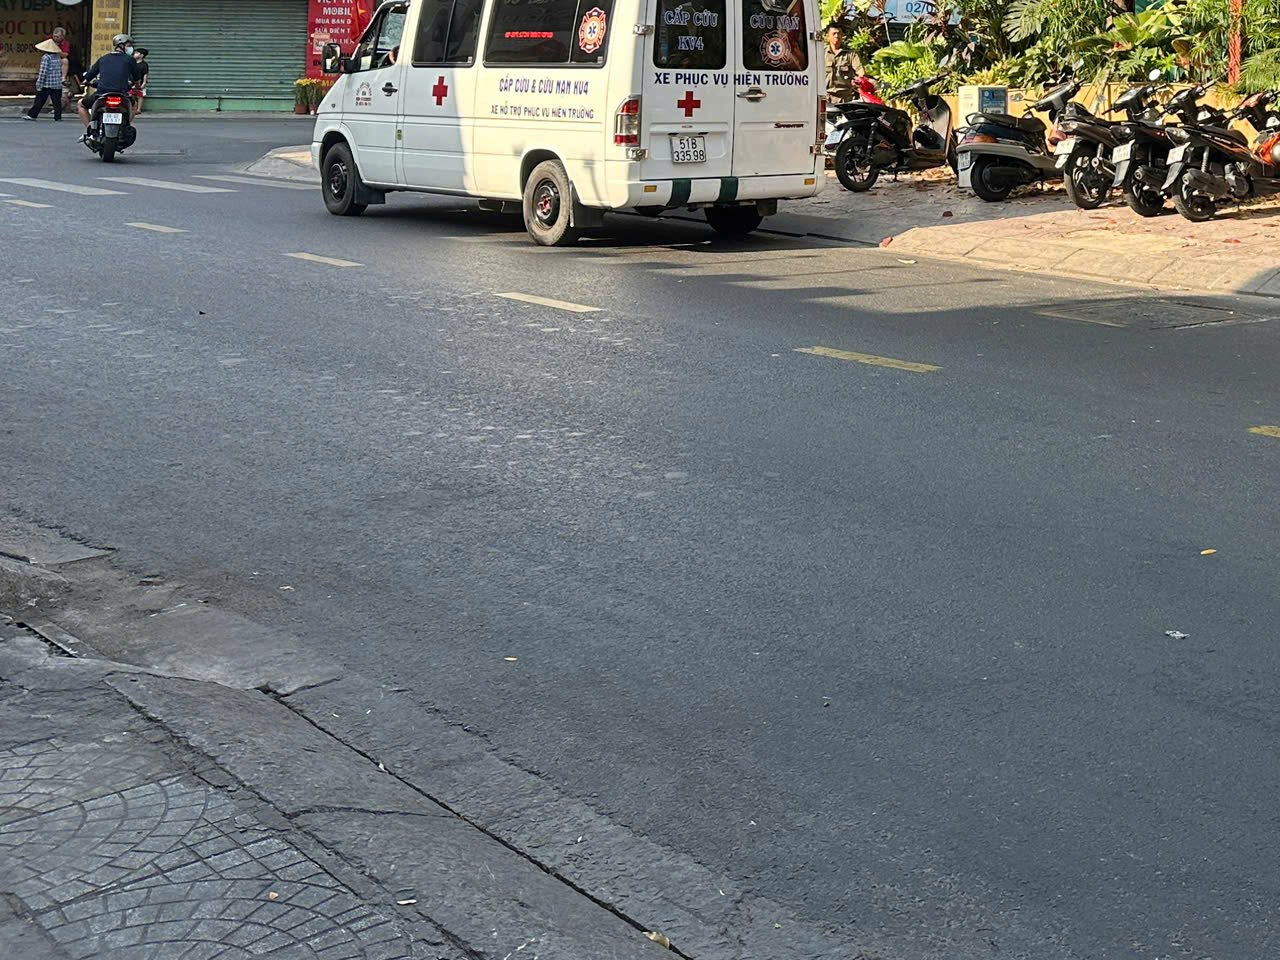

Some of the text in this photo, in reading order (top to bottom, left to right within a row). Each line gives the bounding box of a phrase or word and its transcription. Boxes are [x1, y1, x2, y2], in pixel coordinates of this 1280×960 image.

[678, 35, 704, 51] KV4
[654, 71, 809, 89] XE PHỤC VỤ HIỆN TRƯỜNG
[679, 138, 697, 150] 51B
